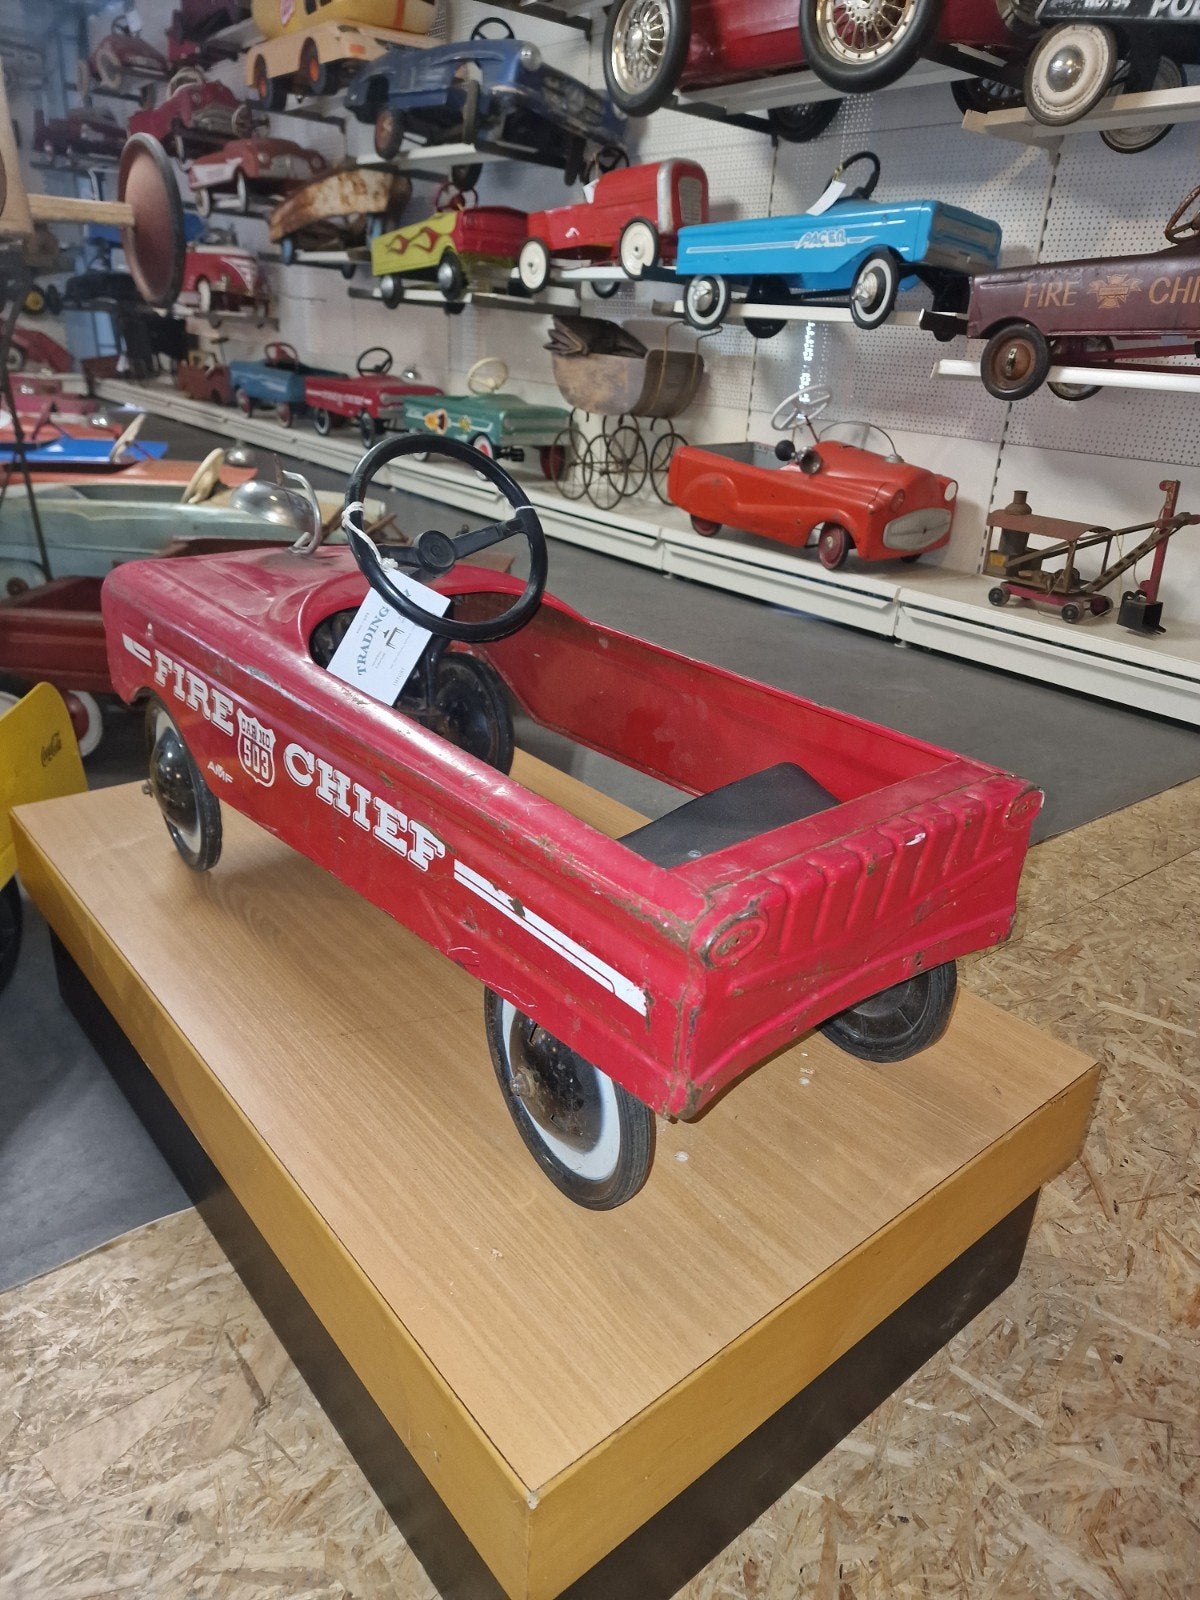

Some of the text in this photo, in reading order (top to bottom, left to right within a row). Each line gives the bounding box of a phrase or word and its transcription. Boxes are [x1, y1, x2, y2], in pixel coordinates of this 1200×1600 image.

[795, 228, 847, 250] PACER
[1023, 279, 1079, 309] FIRE
[356, 605, 390, 676] TRADING
[241, 717, 257, 741] CAR
[154, 649, 446, 872] FIRE CHIEF
[207, 760, 234, 784] AMF
[243, 737, 269, 780] 503
